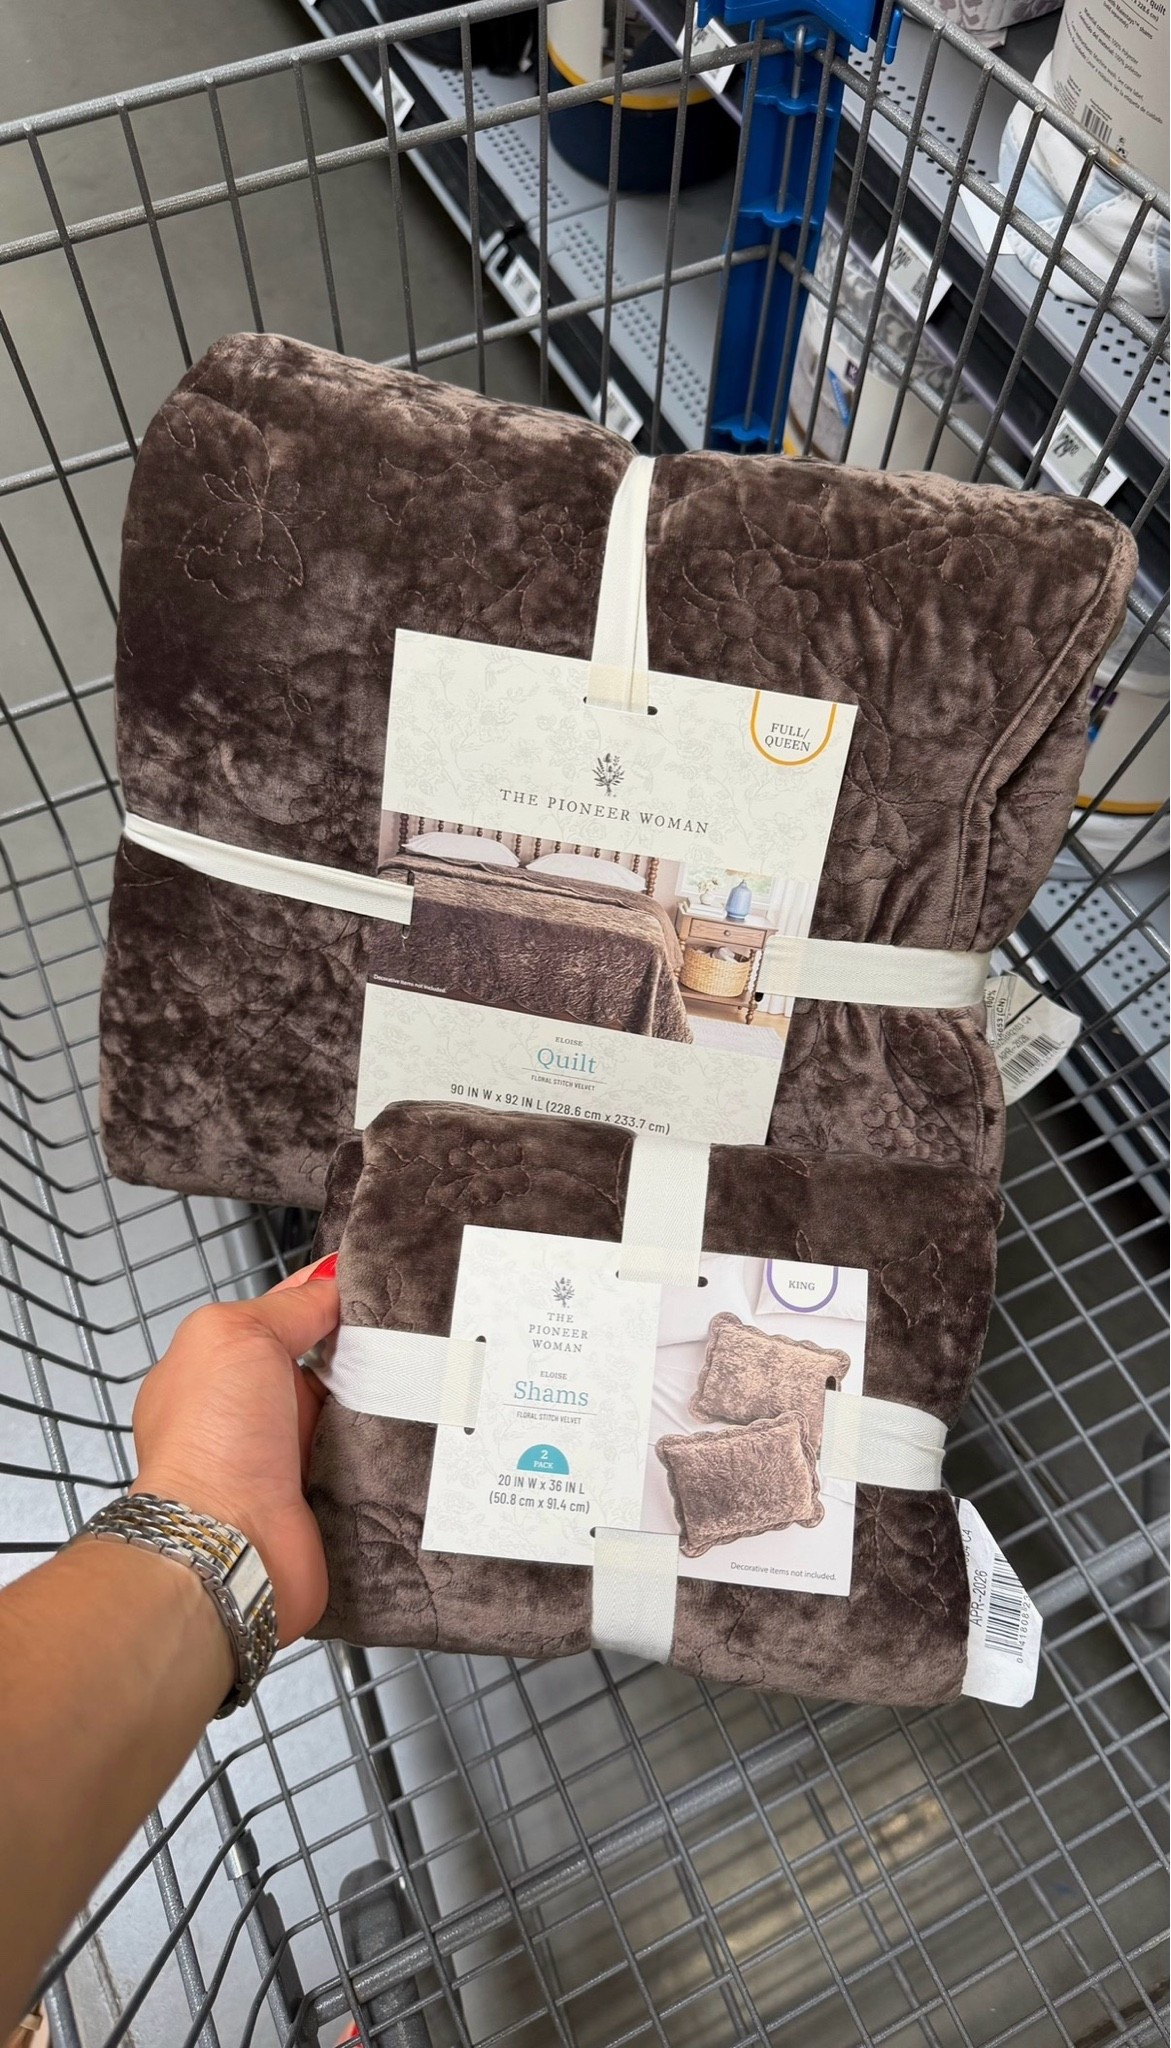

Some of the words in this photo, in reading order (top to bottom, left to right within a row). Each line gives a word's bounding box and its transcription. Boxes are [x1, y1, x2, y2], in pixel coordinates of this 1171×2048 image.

[1150, 0, 1166, 16] quilt
[1149, 12, 1159, 22] cm)
[771, 723, 810, 740] FULL/
[764, 735, 811, 752] QUEEN
[500, 788, 539, 806] THE
[547, 796, 631, 822] PIONEER
[639, 811, 710, 835] WOMAN
[996, 998, 1006, 1017] (CN)
[555, 1036, 584, 1047] ELOISE
[537, 1048, 597, 1074] Quilt
[531, 1074, 552, 1084] FLORAL
[553, 1079, 574, 1088] STITCH
[574, 1082, 596, 1091] VELVET
[450, 1083, 464, 1096] 90
[468, 1086, 479, 1098] IN
[483, 1089, 493, 1100] W
[495, 1094, 502, 1102] x
[505, 1093, 518, 1106] 92
[521, 1096, 533, 1108] IN
[536, 1100, 542, 1110] L
[546, 1100, 582, 1117] (228.6
[584, 1110, 601, 1120] cm
[604, 1114, 612, 1122] x
[614, 1114, 646, 1130] 233.7
[648, 1122, 670, 1136] cm)
[788, 1280, 816, 1291] KING
[547, 1312, 574, 1324] THE
[528, 1324, 588, 1340] PIONEER
[532, 1339, 582, 1352] WOMAN
[540, 1370, 568, 1380] ELOISE
[514, 1380, 589, 1406] Shams
[516, 1411, 538, 1420] FLORAL
[538, 1413, 559, 1422] STITCH
[560, 1416, 582, 1424] VELVET
[540, 1450, 548, 1460] 2
[533, 1460, 554, 1469] PACK
[498, 1474, 512, 1486] 20
[514, 1476, 524, 1488] IN
[528, 1478, 538, 1489] W
[540, 1481, 546, 1490] x
[549, 1480, 562, 1492] 36
[565, 1482, 576, 1494] IN
[578, 1483, 585, 1494] L
[489, 1490, 516, 1506] (50.8
[518, 1496, 535, 1508] cm
[537, 1499, 544, 1508] x
[546, 1498, 567, 1511] 91.4
[570, 1501, 590, 1514] cm)
[962, 1529, 972, 1542] C4
[730, 1562, 769, 1574] Decorative
[770, 1566, 790, 1576] items
[790, 1570, 803, 1578] not
[804, 1571, 836, 1581] included.
[970, 1569, 988, 1628] APR--2026
